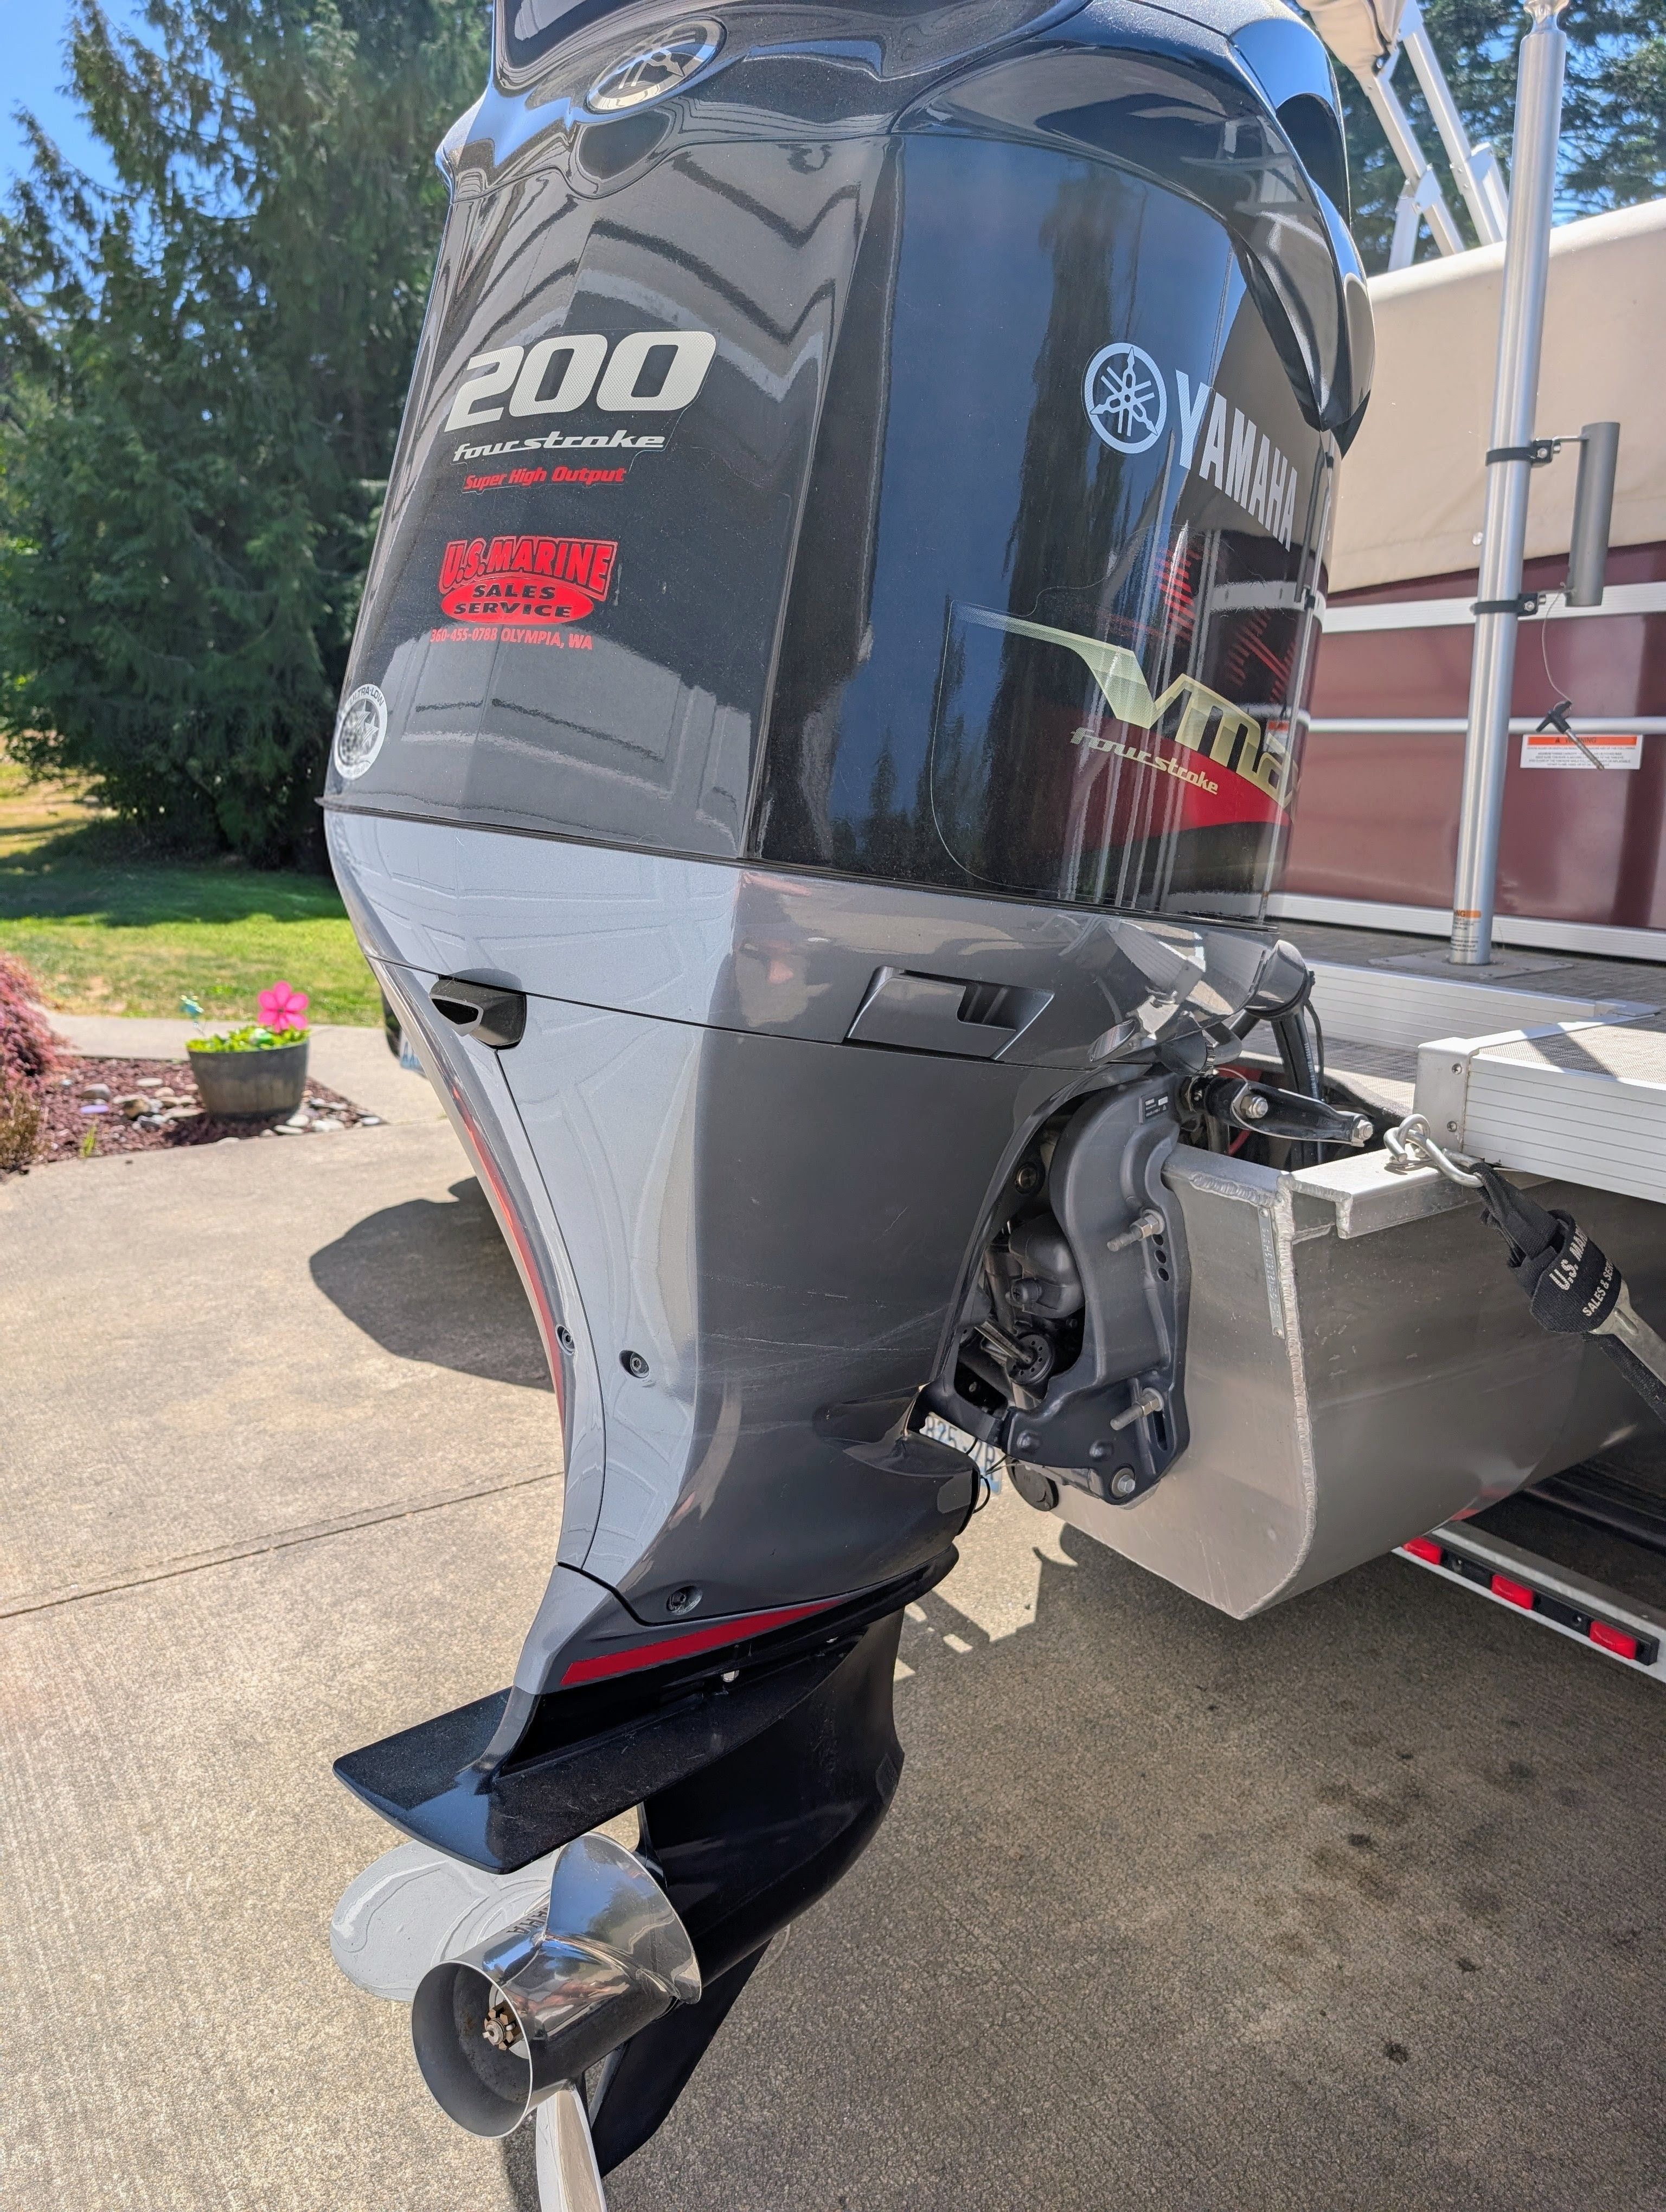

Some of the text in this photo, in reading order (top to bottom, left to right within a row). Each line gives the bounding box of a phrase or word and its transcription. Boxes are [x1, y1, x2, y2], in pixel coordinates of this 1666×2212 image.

[444, 331, 717, 433] 200
[1175, 369, 1298, 552] YAMAHA
[464, 465, 628, 491] Super High Output
[472, 583, 558, 600] SALES
[453, 601, 573, 619] SERVICE
[430, 627, 593, 650] 360-455-0788 OLYMPIA, WA
[1548, 1259, 1579, 1291] U.S.
[1581, 1286, 1606, 1317] SALES
[1600, 1279, 1609, 1290] &
